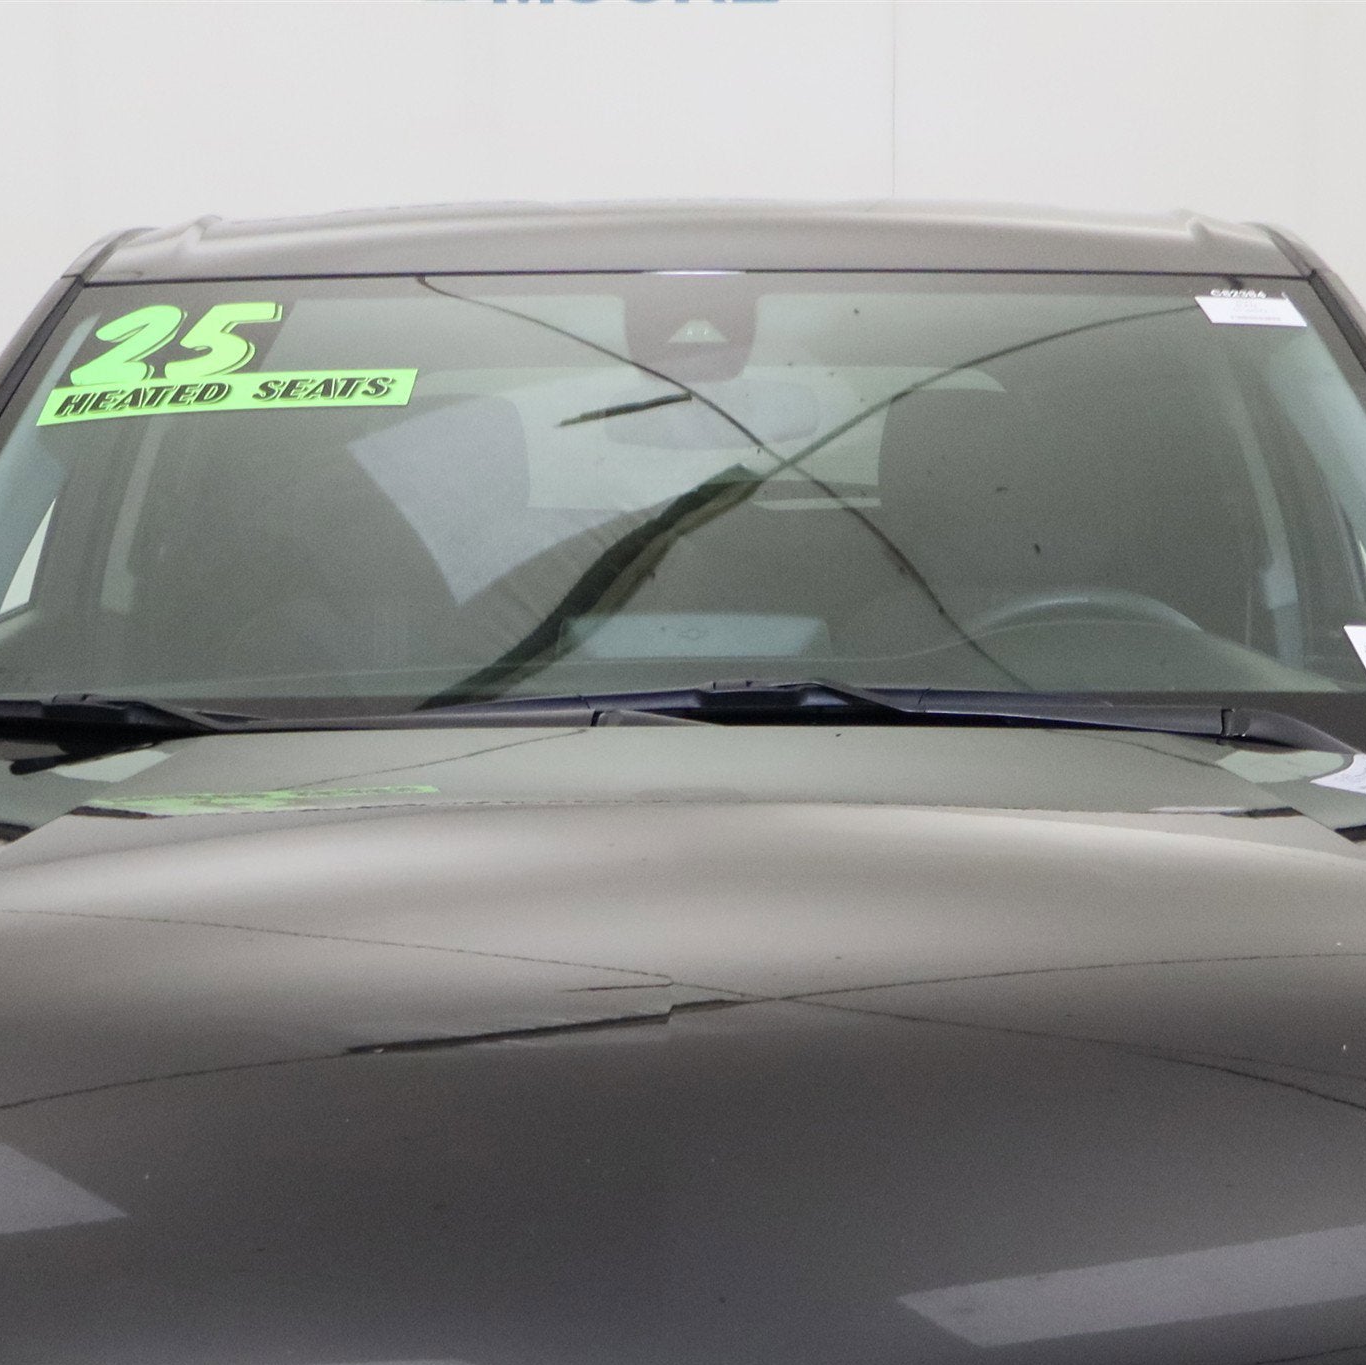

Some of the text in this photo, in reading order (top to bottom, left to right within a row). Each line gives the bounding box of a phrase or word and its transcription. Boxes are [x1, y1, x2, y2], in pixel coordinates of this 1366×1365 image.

[69, 301, 283, 386] 25
[53, 375, 393, 418] HEATED SEATS
